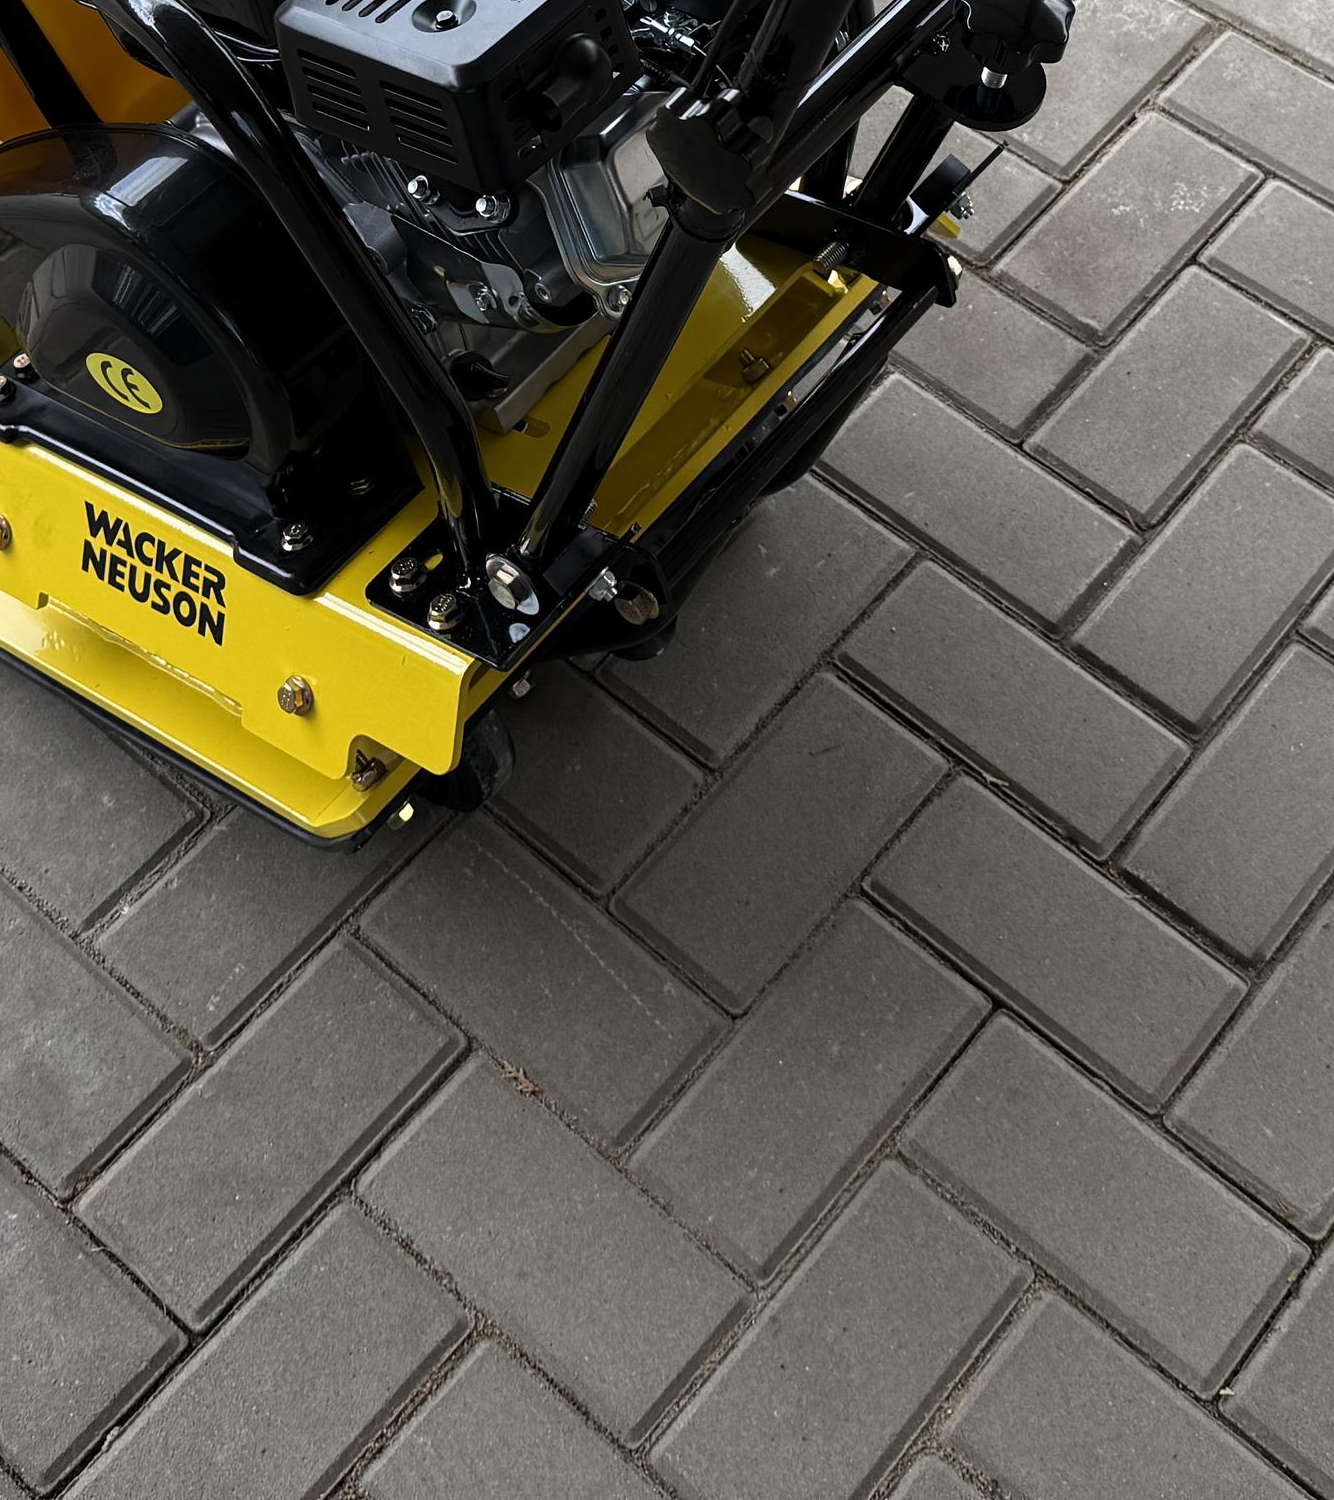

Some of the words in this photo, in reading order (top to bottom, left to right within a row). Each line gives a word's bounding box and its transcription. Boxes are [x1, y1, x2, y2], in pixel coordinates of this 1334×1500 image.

[100, 360, 152, 410] CE
[81, 538, 226, 647] NEUSON
[84, 500, 227, 609] WACKER
